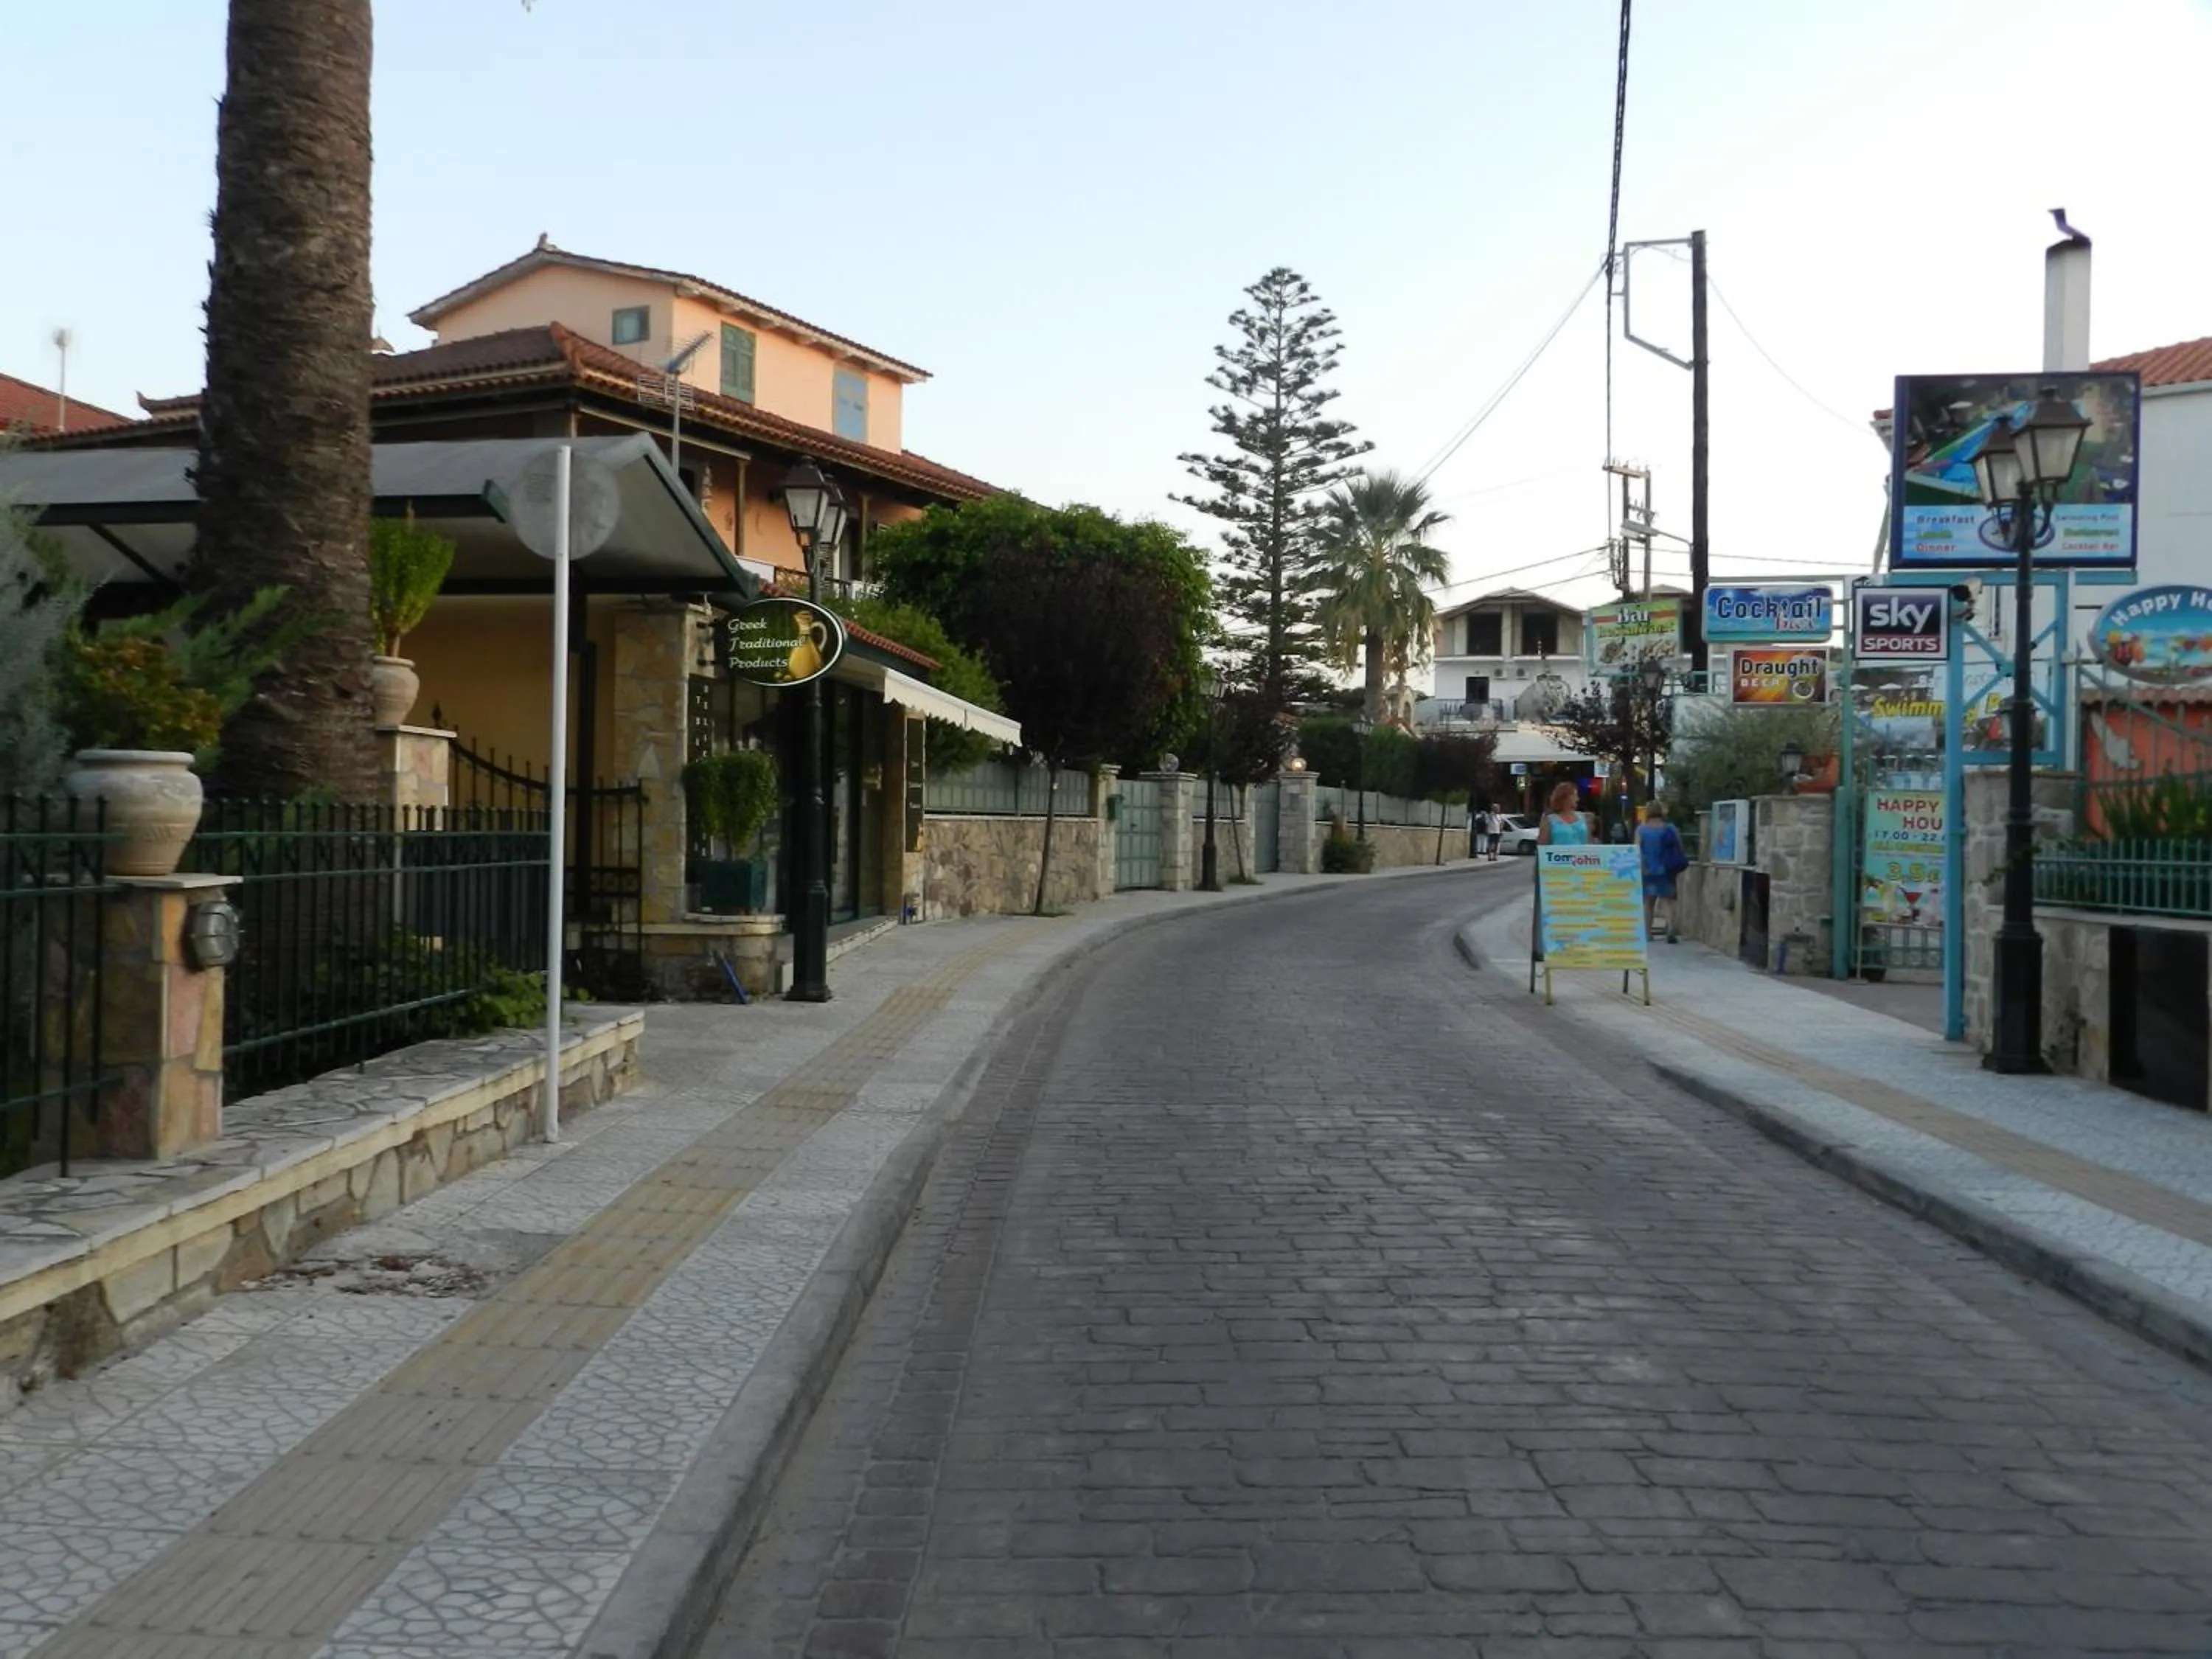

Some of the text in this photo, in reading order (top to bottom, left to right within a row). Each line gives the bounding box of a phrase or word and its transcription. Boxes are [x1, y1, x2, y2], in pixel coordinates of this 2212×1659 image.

[1916, 513, 1975, 525] Breakfast
[1915, 542, 1955, 553] Dinner
[1717, 595, 1822, 619] Cocktail
[2110, 593, 2182, 627] Happy
[727, 618, 767, 633] Greek
[729, 636, 804, 653] Traditional
[1863, 637, 1938, 650] SPORTS
[728, 656, 788, 669] Products
[1741, 658, 1819, 678] Draught
[1877, 799, 1939, 813] HAPPY
[1902, 816, 1943, 830] HOU
